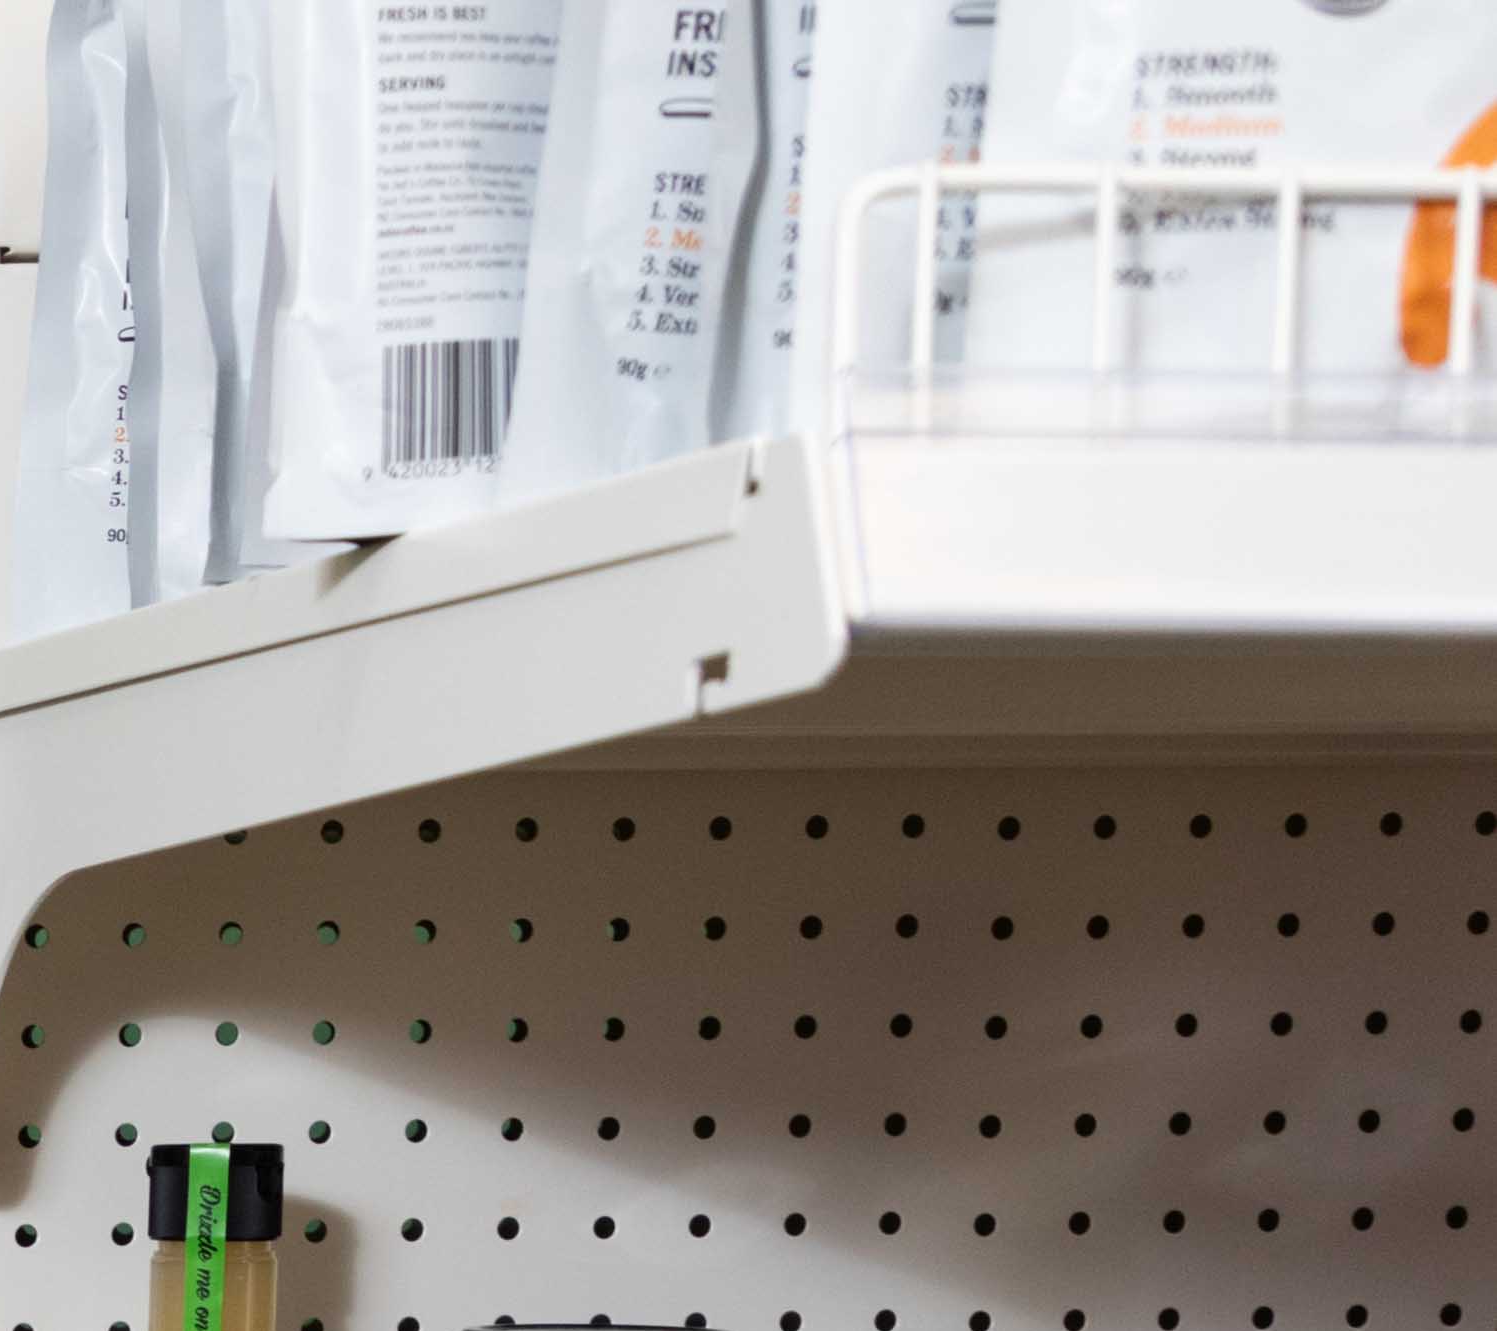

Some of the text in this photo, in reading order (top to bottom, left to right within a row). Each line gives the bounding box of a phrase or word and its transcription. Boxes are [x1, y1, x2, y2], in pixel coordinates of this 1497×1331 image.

[378, 7, 486, 21] FRESH IS BEST
[378, 76, 446, 93] SERVING
[107, 528, 129, 545] 90
[197, 1184, 221, 1262] Drizzle
[196, 1267, 213, 1301] me
